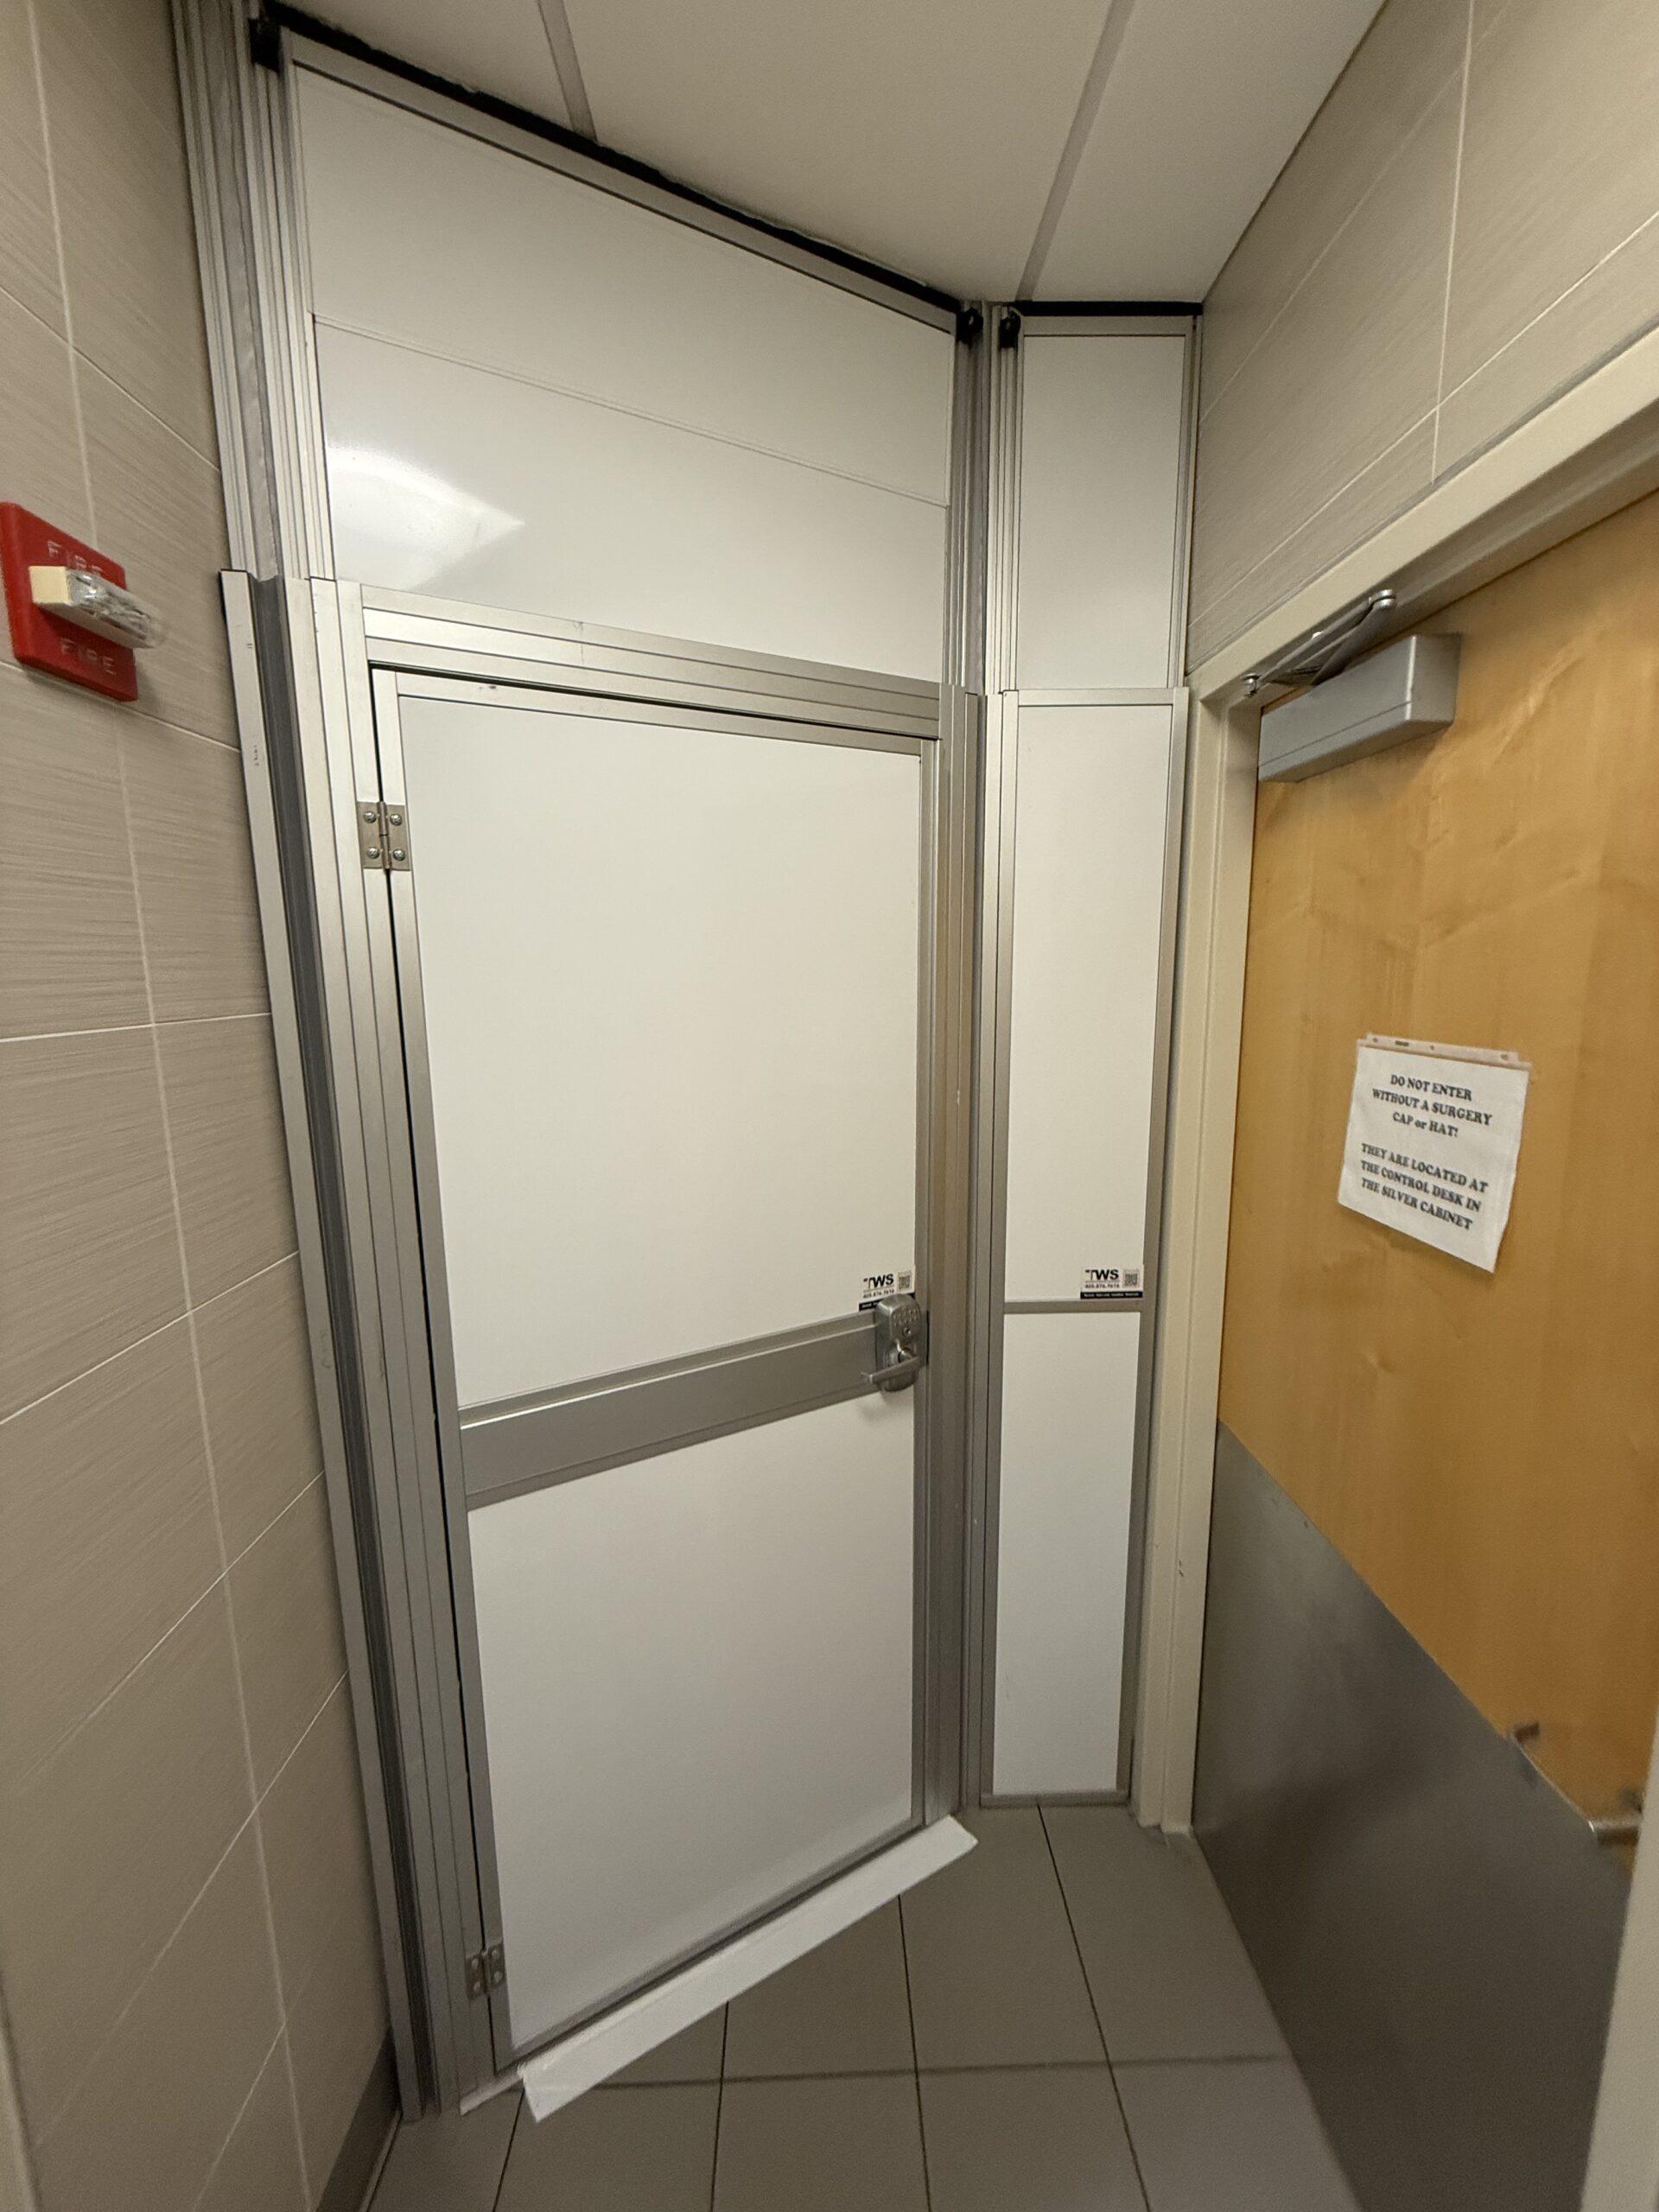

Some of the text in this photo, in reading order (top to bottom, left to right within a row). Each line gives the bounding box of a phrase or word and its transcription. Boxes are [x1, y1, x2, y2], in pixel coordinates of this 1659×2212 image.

[60, 638, 117, 676] FIRE
[1372, 1088, 1493, 1126] WITHOUT A SURGERY
[1390, 1074, 1472, 1102] DO NOT ENTER
[1392, 1111, 1459, 1138] CAP or HAT!
[1360, 1160, 1482, 1212] THE CONTROL DESK IN
[1361, 1142, 1489, 1193] THEY ARE LOCATED AT
[1362, 1178, 1473, 1230] THE SILVER CABINET
[863, 1274, 894, 1288] TWS
[1084, 1268, 1120, 1281] TWS
